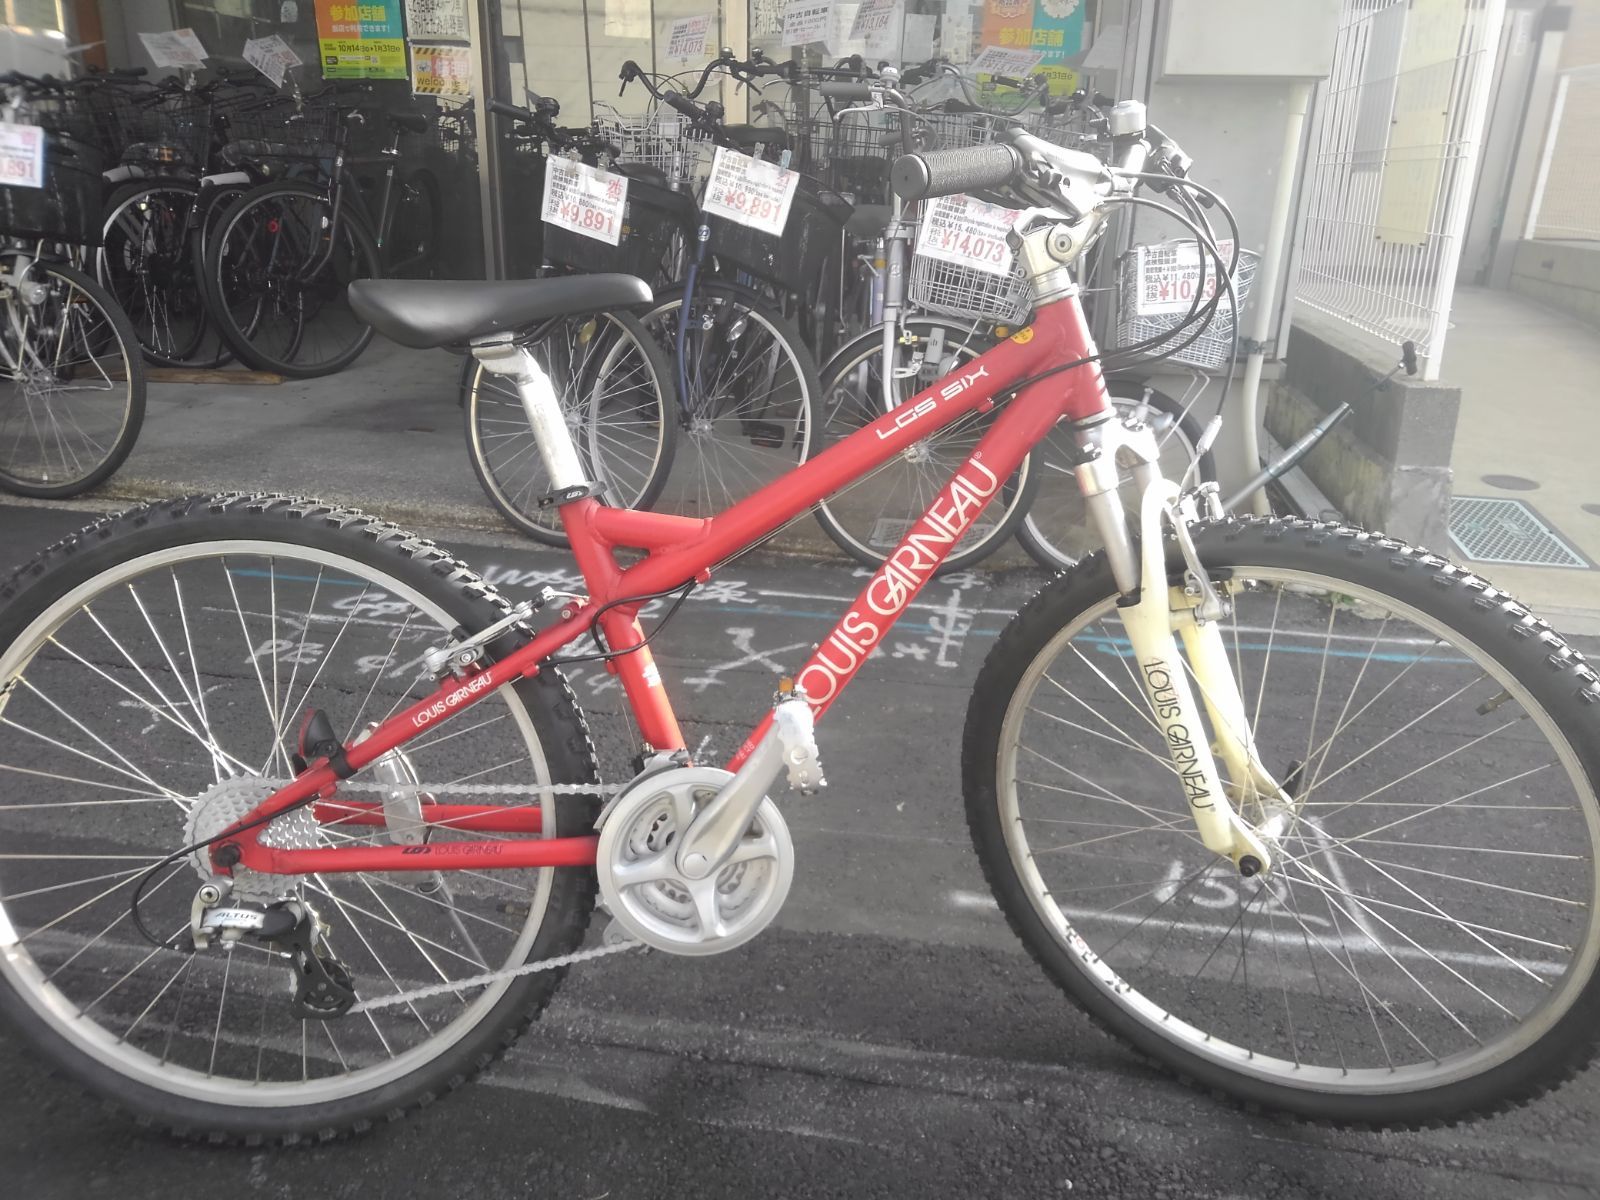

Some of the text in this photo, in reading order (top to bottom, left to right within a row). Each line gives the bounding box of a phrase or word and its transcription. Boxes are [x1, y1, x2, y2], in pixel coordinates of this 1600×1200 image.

[329, 5, 386, 22] 参加店舗
[998, 27, 1064, 47] 参加店舗
[416, 76, 461, 87] welco
[559, 198, 614, 236] ¥9,891
[722, 186, 782, 224] ¥9,891
[938, 228, 1006, 265] ¥14,073
[940, 365, 990, 401] SIX
[797, 458, 998, 716] OUIS GARNEAU
[412, 671, 493, 727] LOUIS GARNEAU
[1143, 660, 1214, 809] LOUIS GARNEAU
[216, 911, 258, 920] ALTUS
